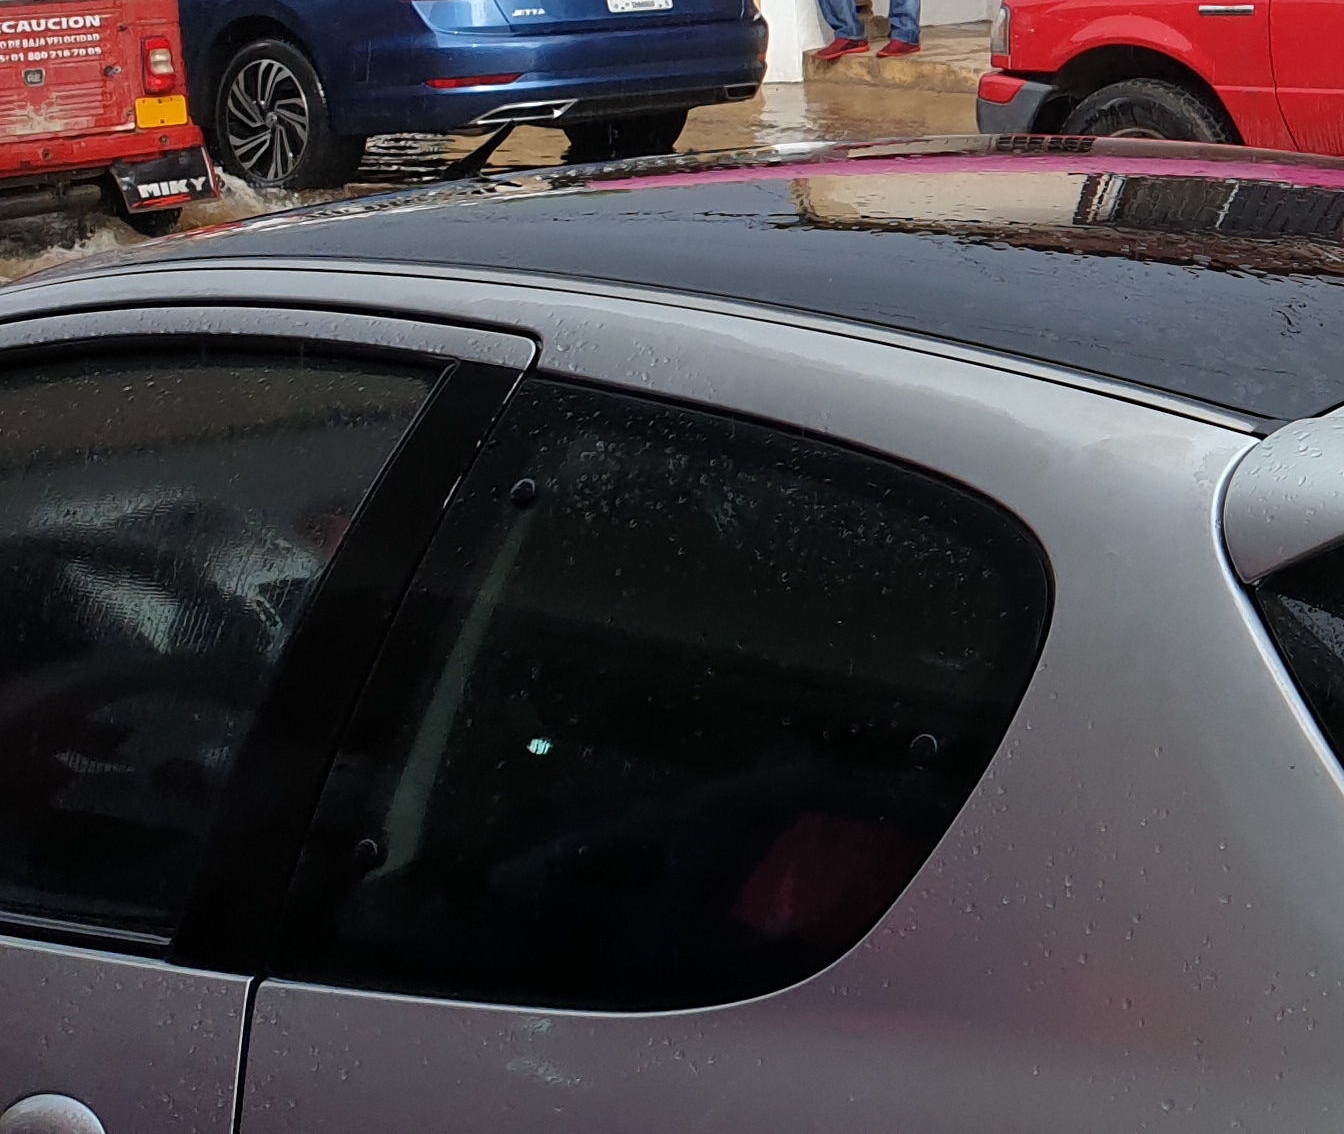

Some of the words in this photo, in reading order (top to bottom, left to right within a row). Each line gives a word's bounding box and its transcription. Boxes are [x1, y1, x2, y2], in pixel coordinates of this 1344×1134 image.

[512, 8, 546, 17] JETTA
[0, 15, 101, 34] CAUCION
[138, 177, 206, 198] MIKY
